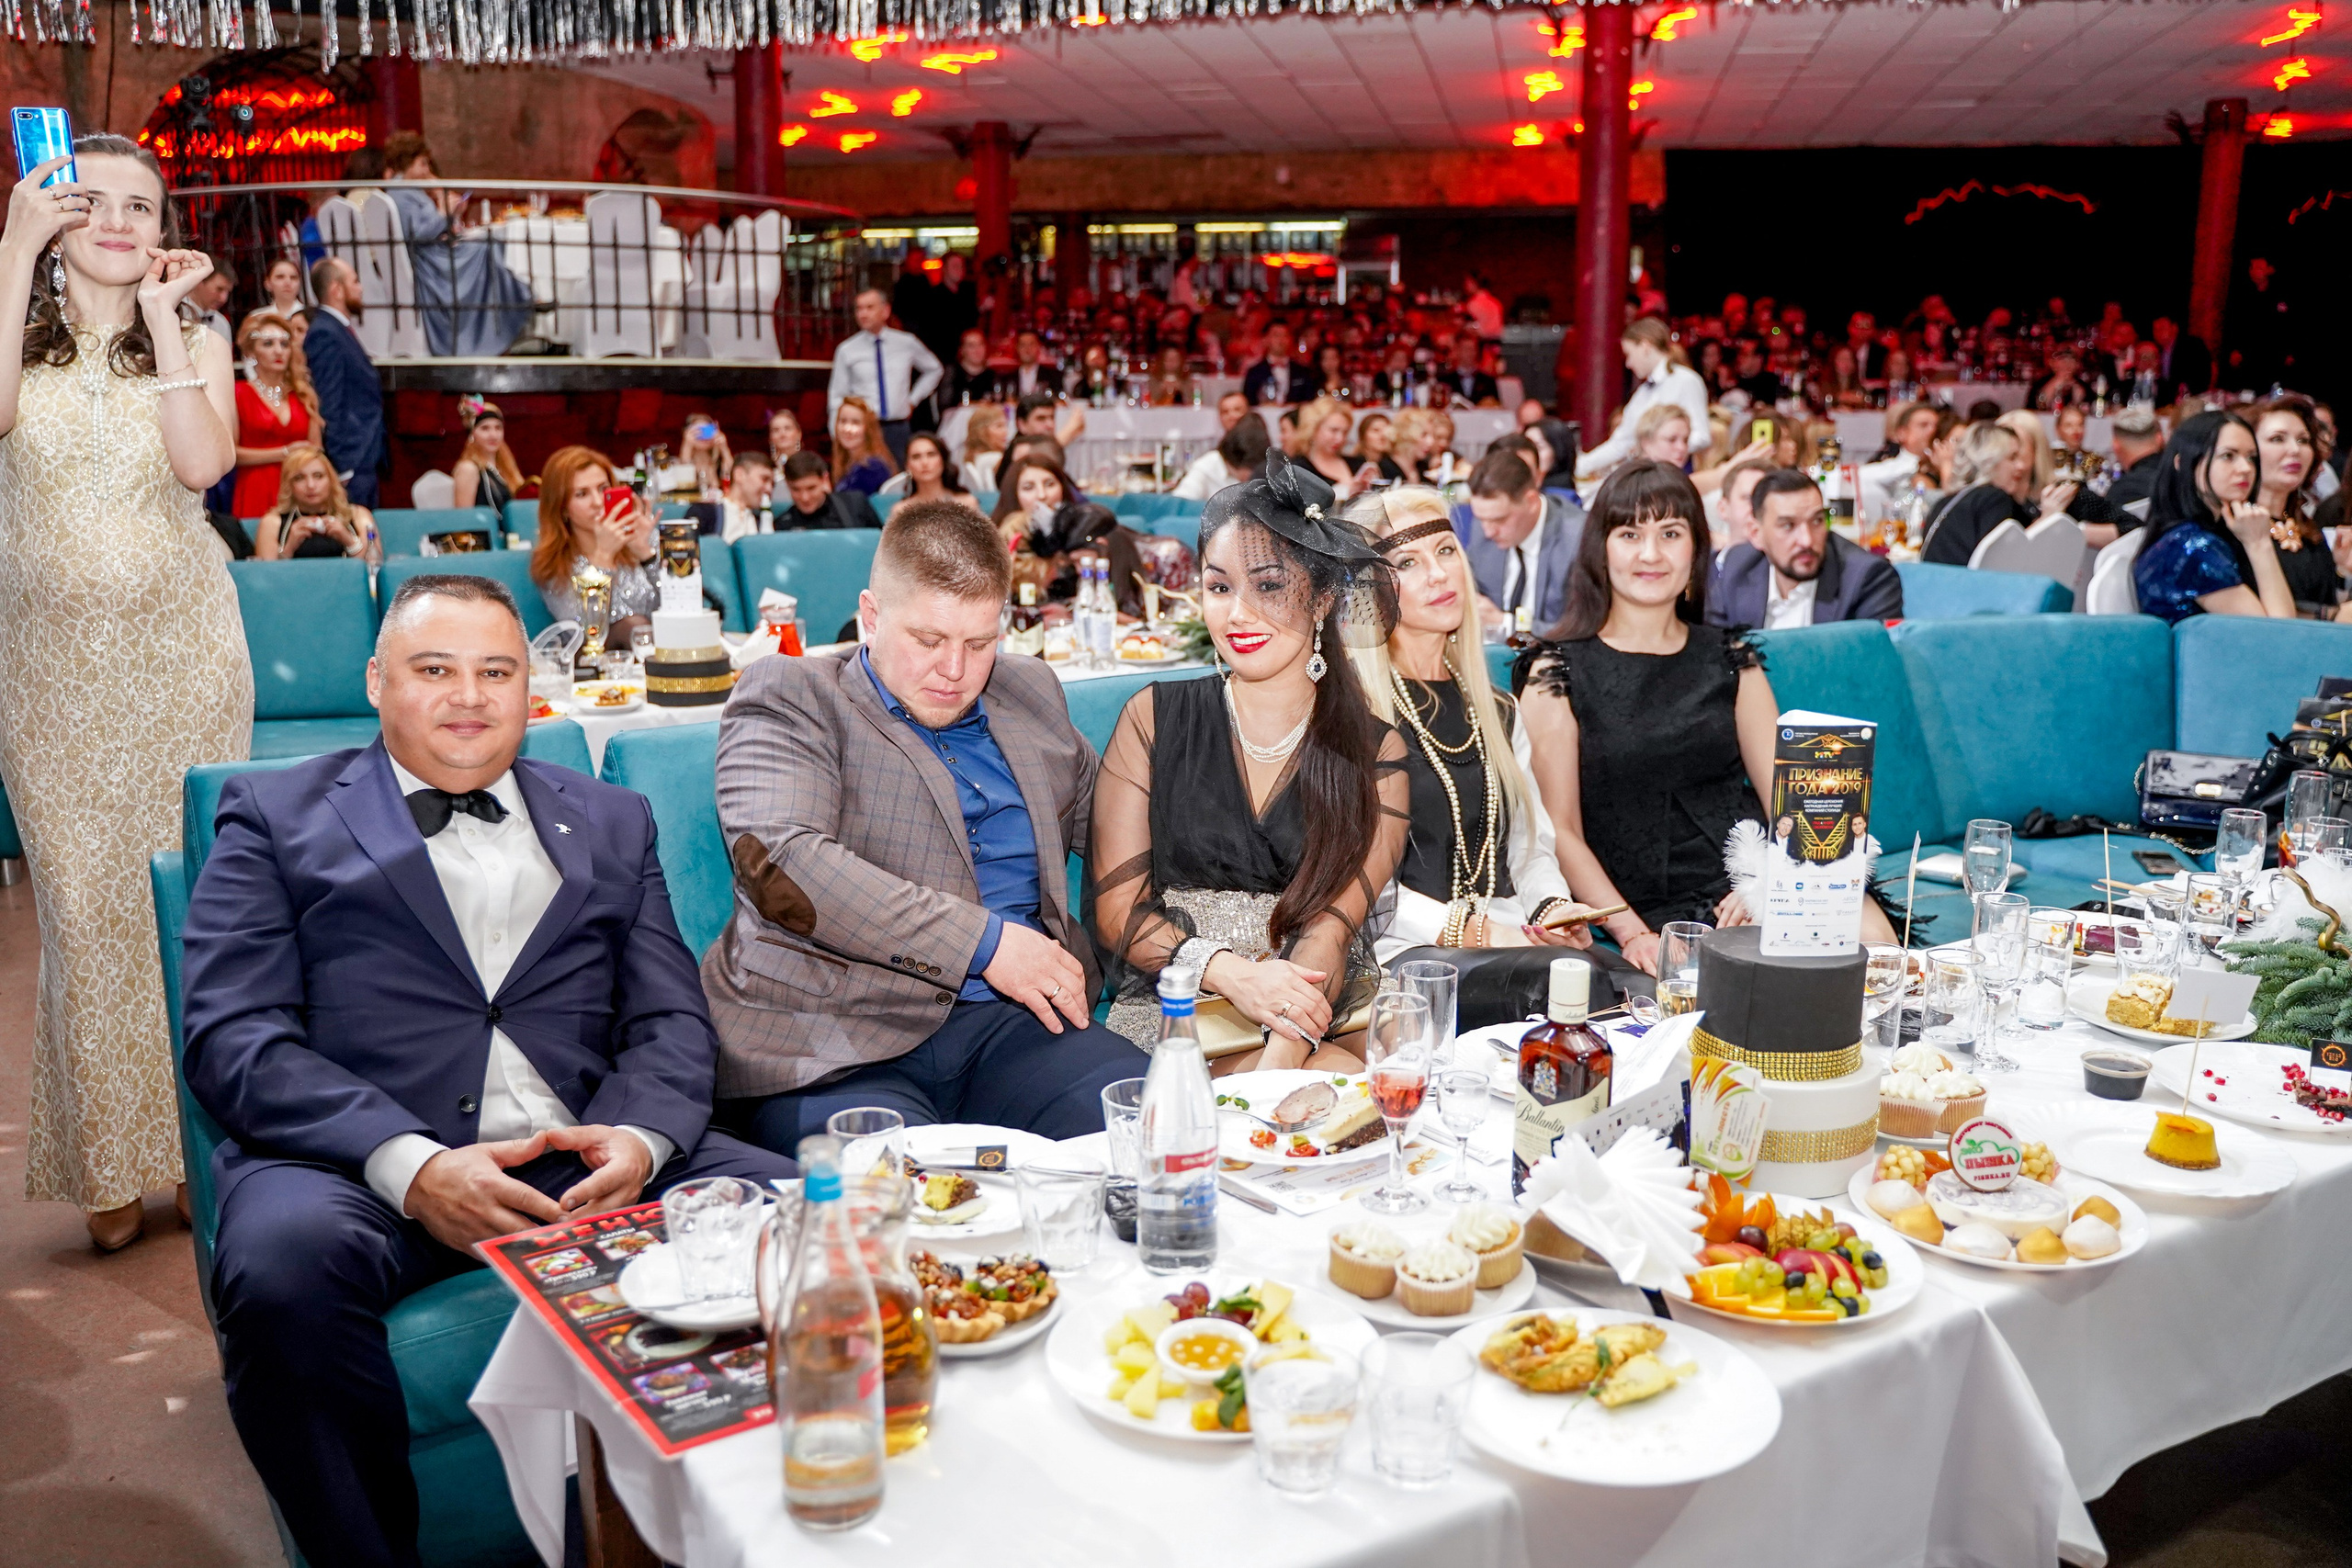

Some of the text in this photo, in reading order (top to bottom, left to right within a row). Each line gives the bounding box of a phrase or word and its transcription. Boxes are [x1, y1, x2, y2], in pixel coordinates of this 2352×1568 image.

[1789, 768, 1862, 780] ПРИЗНАНИЕ
[1789, 782, 1860, 796] ГОДА 2019
[1964, 1154, 2015, 1169] ПЫШКА
[1973, 1172, 2011, 1181] PISHKA.RU
[600, 1227, 636, 1239] САЛАТЫ
